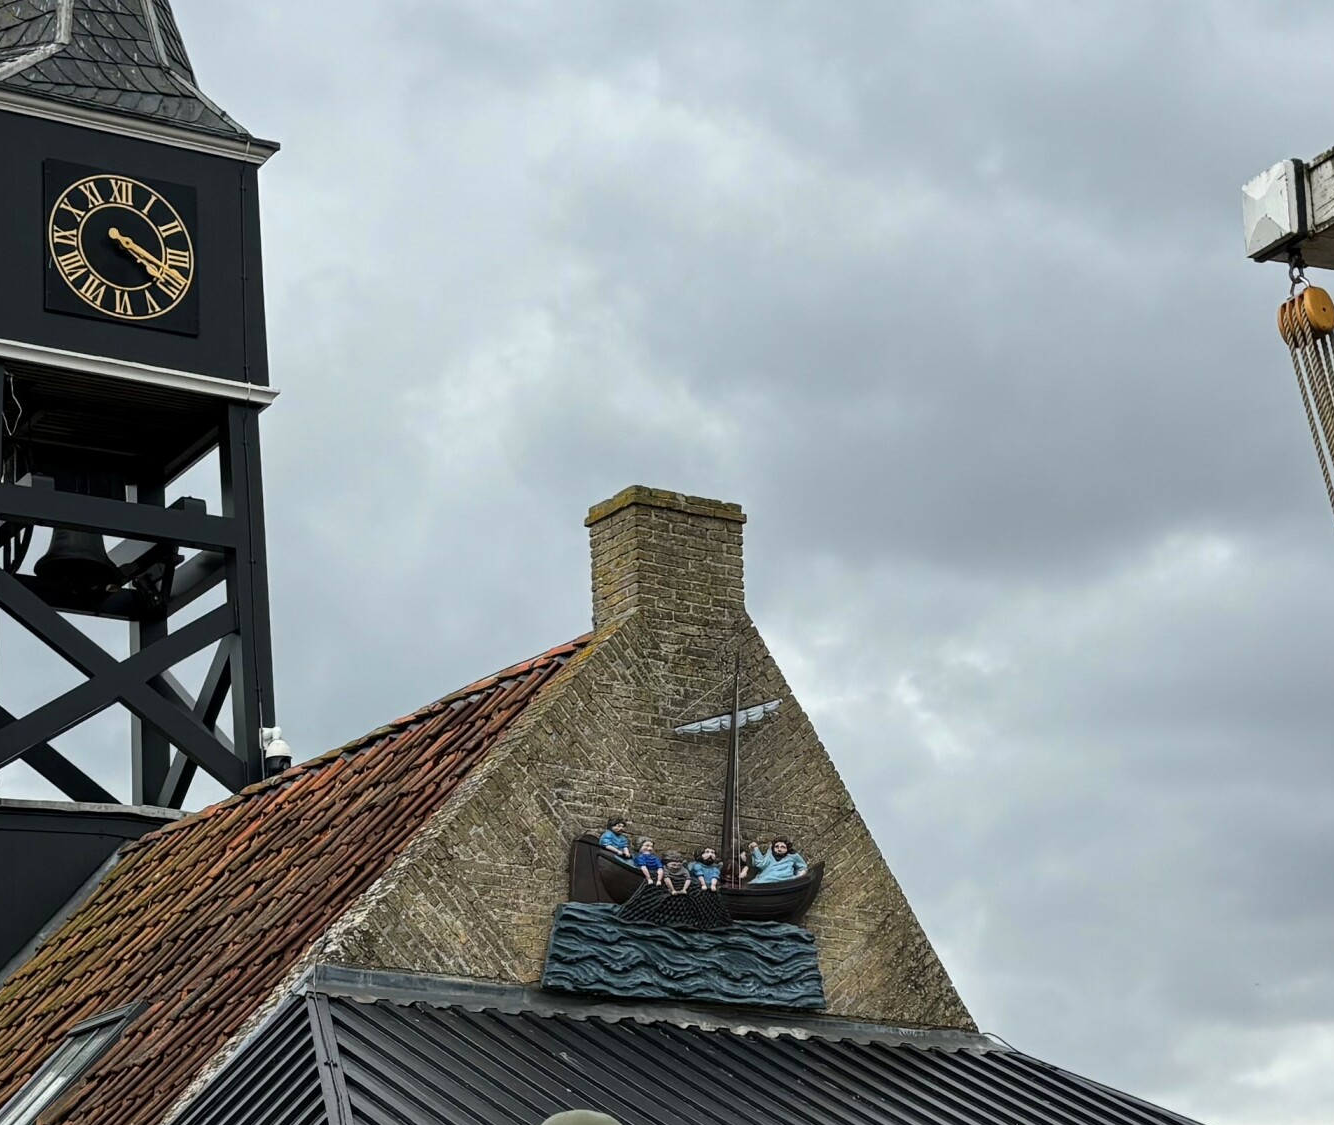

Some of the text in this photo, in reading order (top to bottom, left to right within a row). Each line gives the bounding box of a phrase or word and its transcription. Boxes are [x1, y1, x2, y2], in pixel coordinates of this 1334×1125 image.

[79, 181, 105, 208] XI
[109, 179, 133, 206] XII
[142, 194, 158, 215] I
[60, 198, 85, 222] X
[53, 226, 77, 245] IX
[158, 220, 183, 238] II
[58, 251, 88, 282] VIII
[166, 248, 190, 269] III
[79, 274, 107, 307] VII
[115, 289, 133, 315] VI
[145, 289, 161, 314] V
